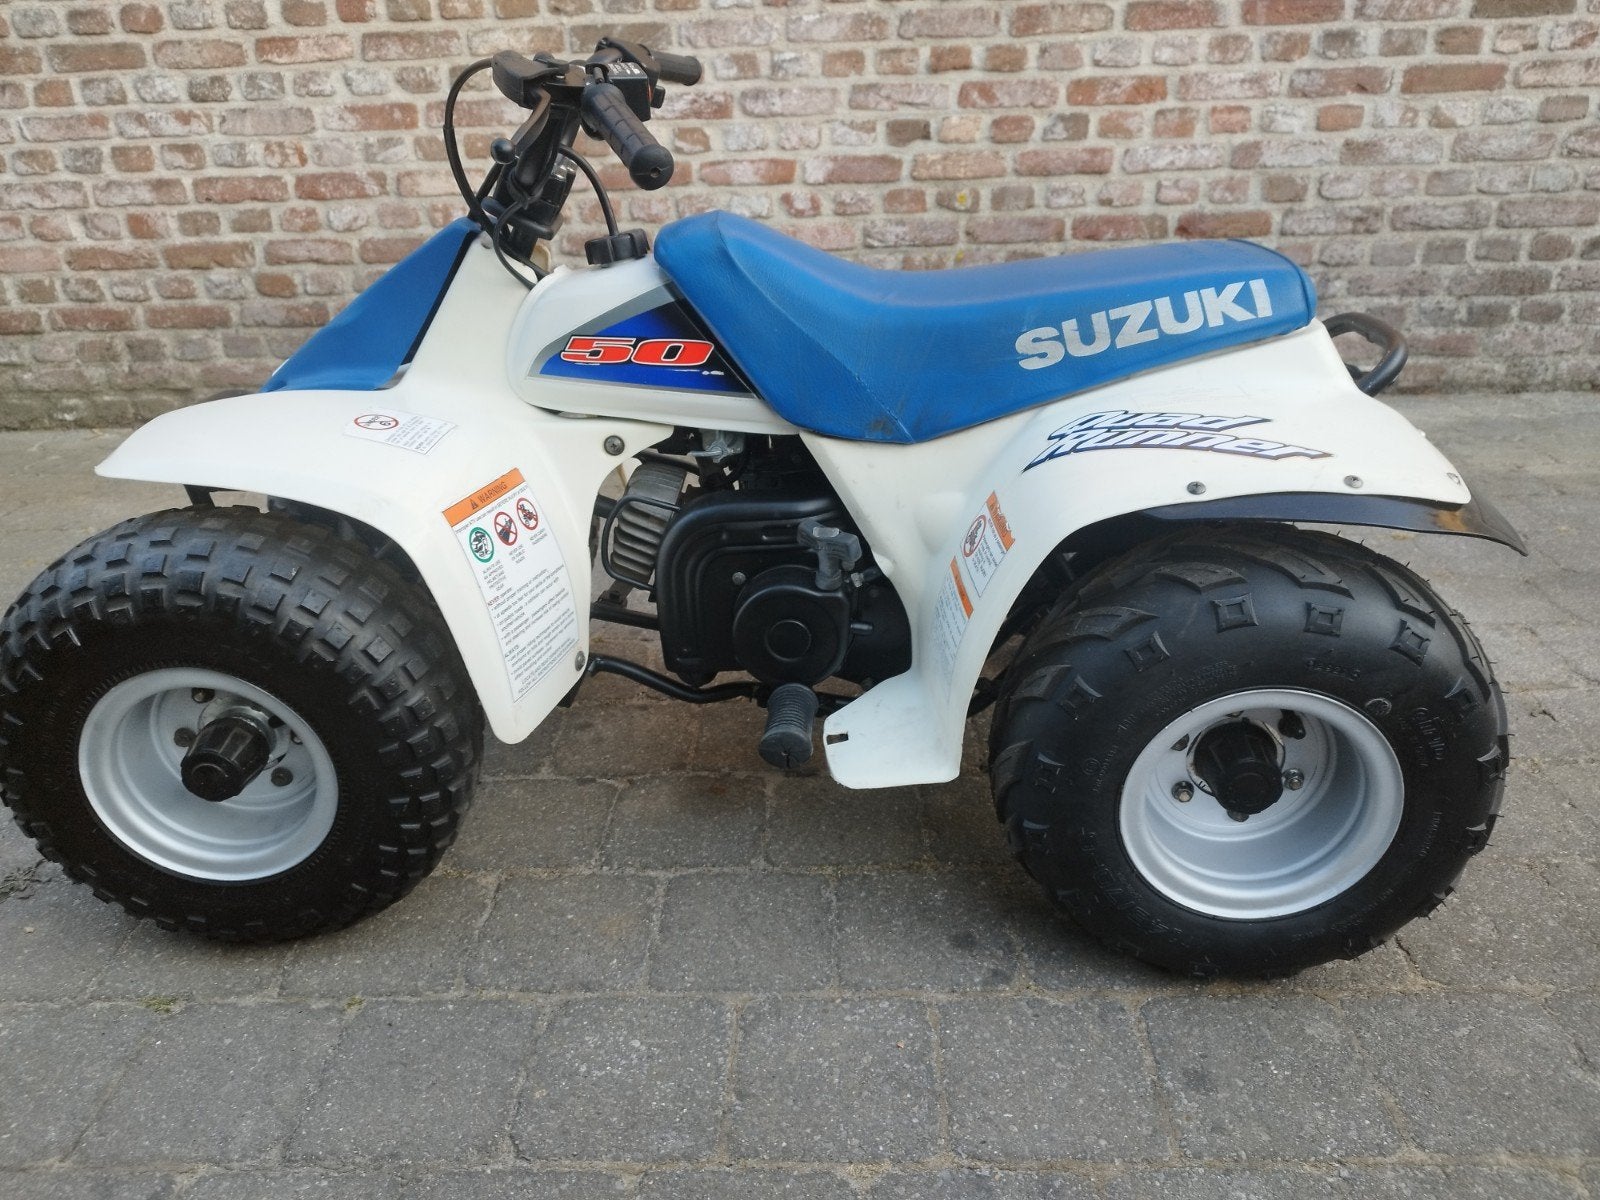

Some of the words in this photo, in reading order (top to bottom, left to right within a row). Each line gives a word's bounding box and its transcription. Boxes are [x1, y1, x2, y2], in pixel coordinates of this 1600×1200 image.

[1015, 279, 1273, 370] SUZUKI
[560, 335, 714, 367] 50
[1046, 410, 1274, 441] Quad
[1020, 428, 1335, 474] Runner
[477, 481, 508, 504] WARNING
